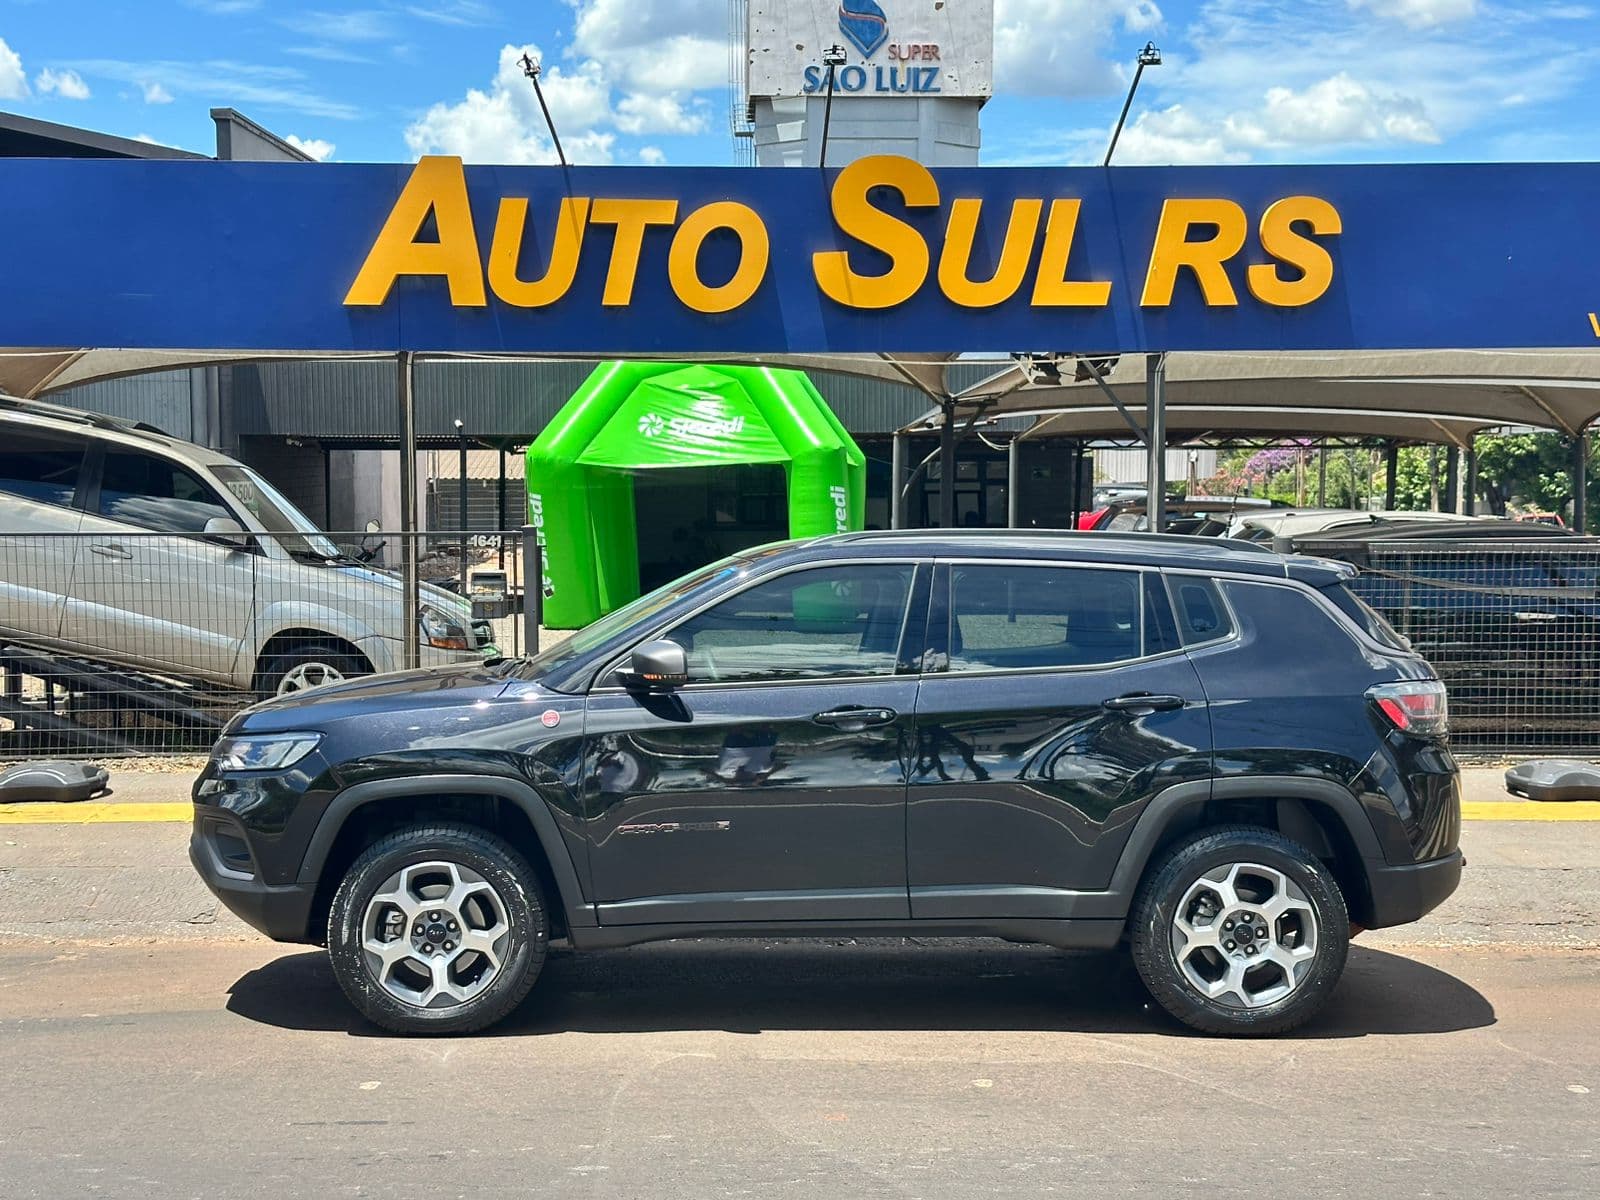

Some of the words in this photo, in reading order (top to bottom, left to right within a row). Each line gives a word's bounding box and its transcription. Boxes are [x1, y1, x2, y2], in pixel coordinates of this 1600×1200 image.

[888, 43, 941, 61] SUPER
[875, 66, 941, 93] LUIZ
[342, 155, 769, 314] AUTO
[813, 154, 1112, 309] SUL
[1139, 195, 1342, 307] RS
[470, 534, 502, 548] 1641
